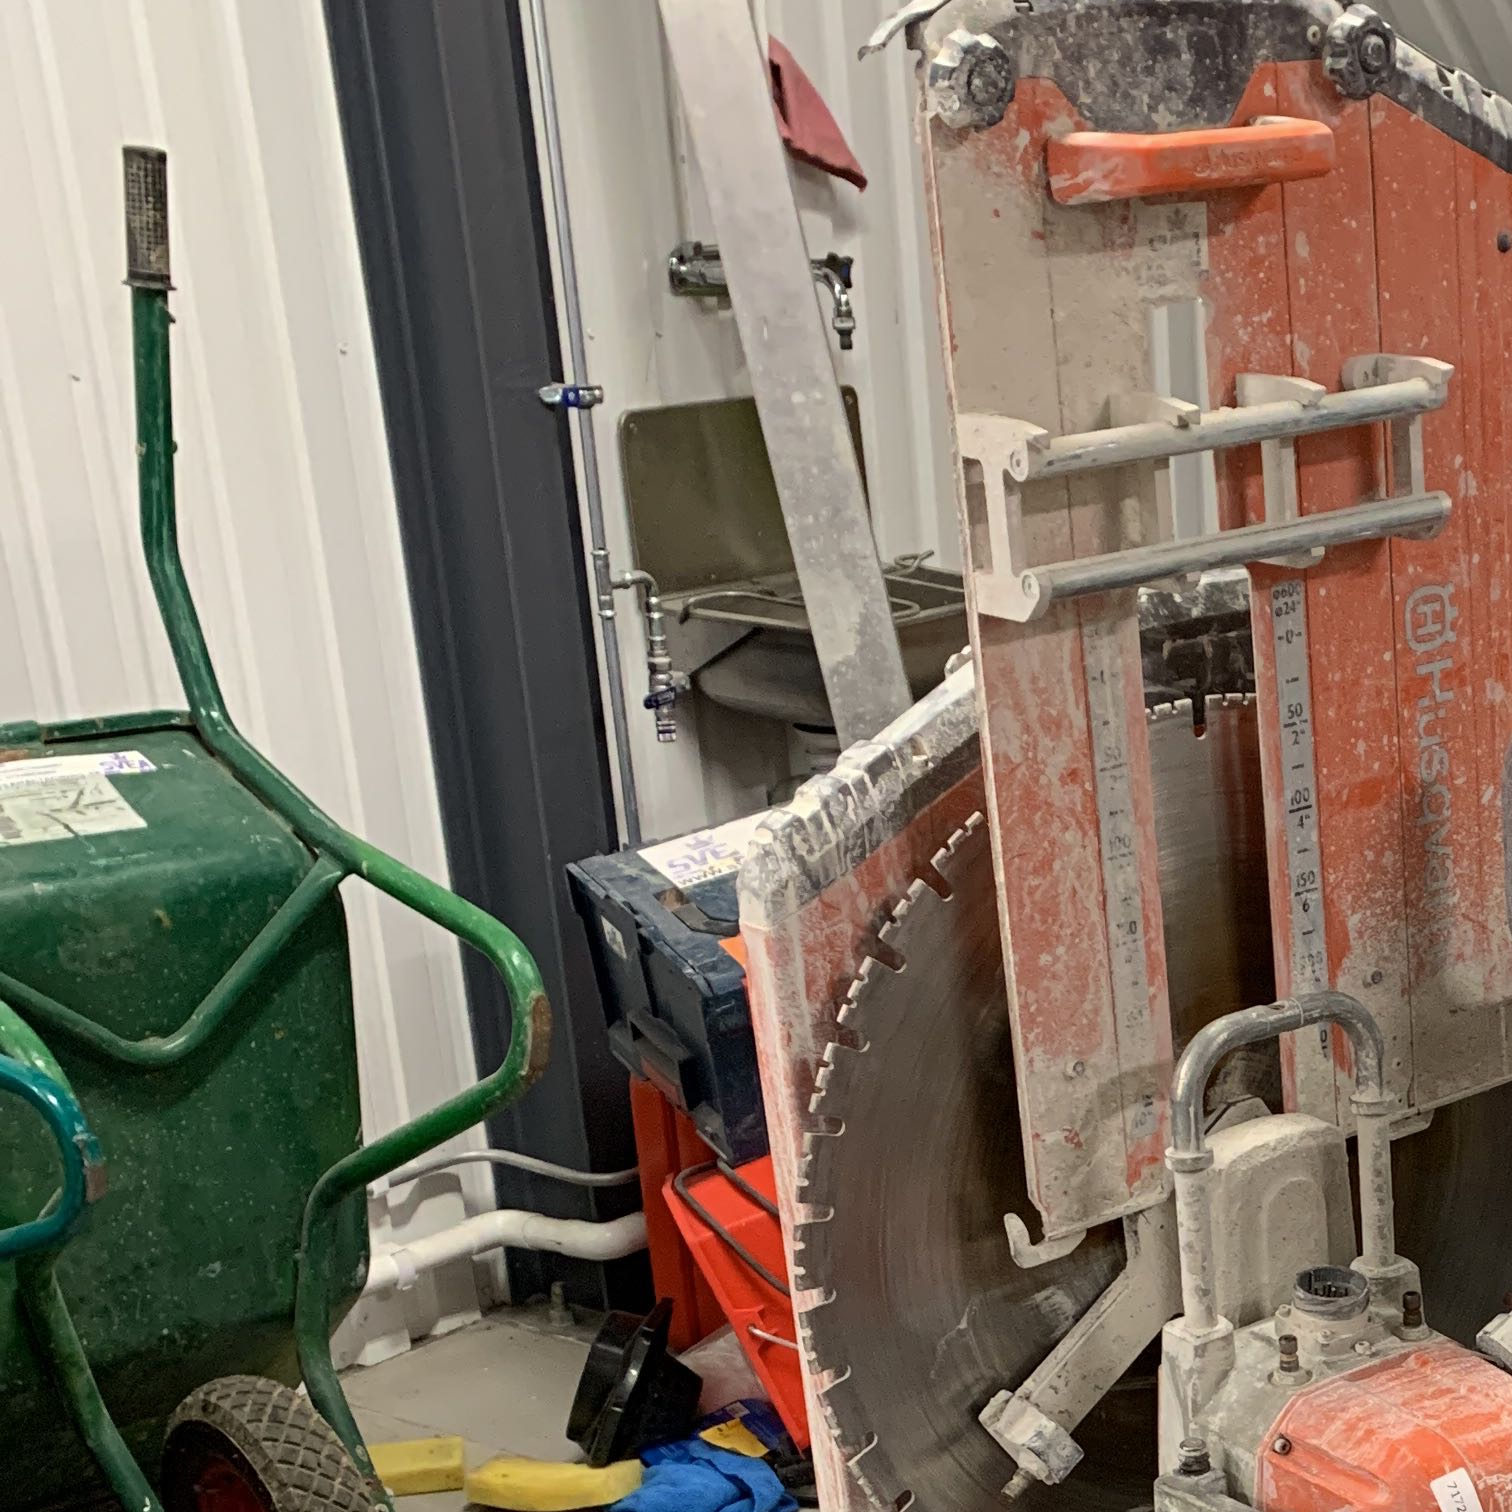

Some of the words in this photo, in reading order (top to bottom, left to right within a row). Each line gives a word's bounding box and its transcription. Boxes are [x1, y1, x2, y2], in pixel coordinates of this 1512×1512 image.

[1287, 703, 1304, 719] 50
[1291, 787, 1310, 806] 100
[1296, 870, 1316, 888] 150
